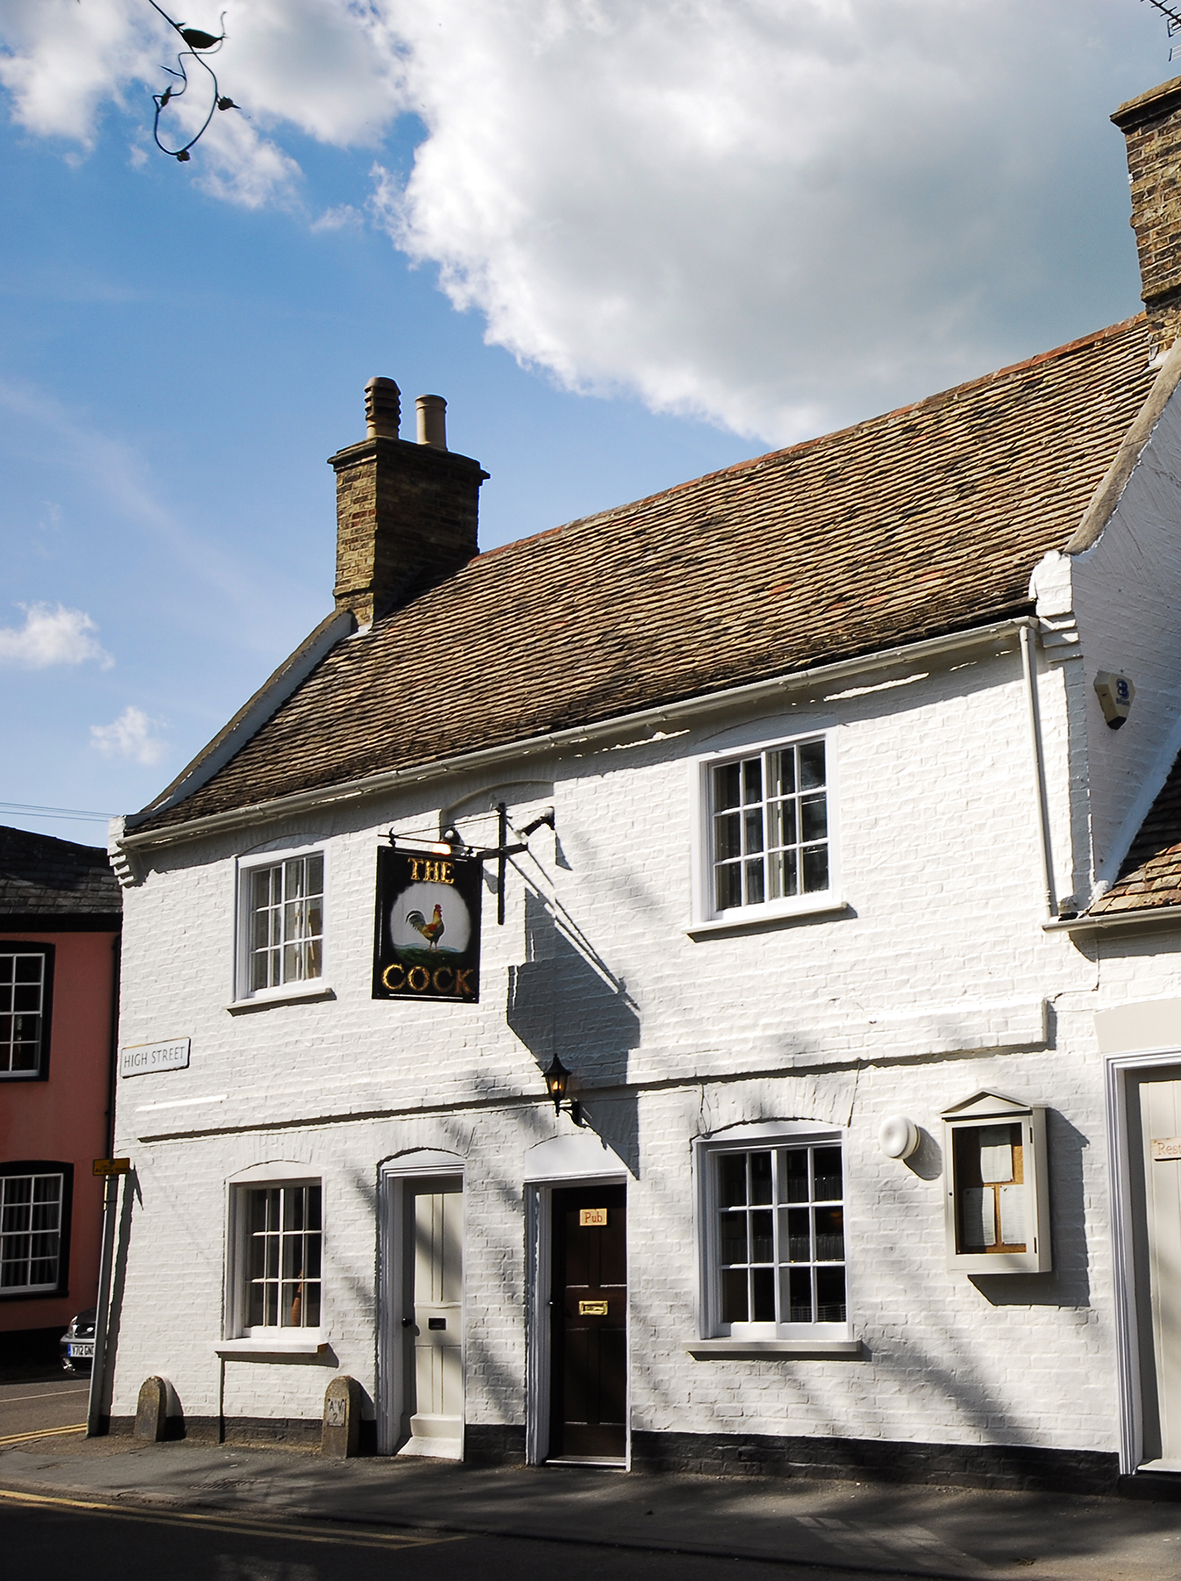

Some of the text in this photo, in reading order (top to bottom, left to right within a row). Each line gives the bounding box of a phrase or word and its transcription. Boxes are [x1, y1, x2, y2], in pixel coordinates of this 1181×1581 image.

[408, 857, 455, 884] THE
[381, 962, 474, 995] COCK
[124, 1046, 185, 1068] HIGH STREET
[584, 1211, 603, 1223] Pub
